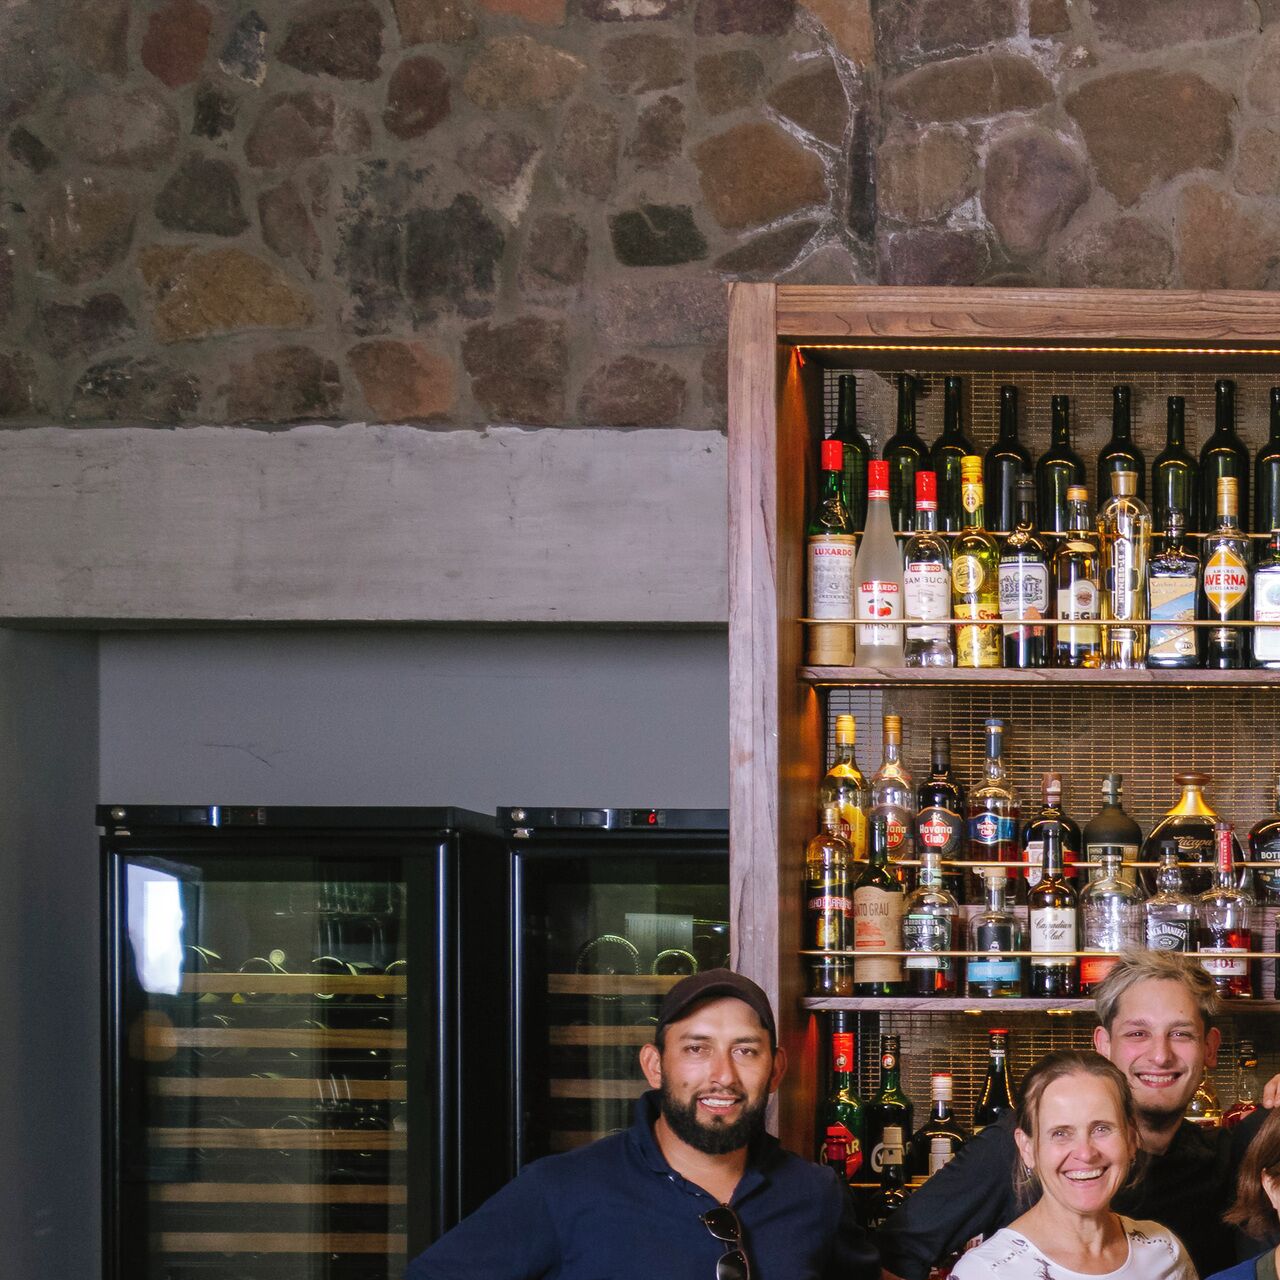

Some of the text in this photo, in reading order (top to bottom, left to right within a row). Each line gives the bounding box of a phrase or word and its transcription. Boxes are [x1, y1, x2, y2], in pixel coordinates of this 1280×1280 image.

[814, 548, 853, 557] LUXARDO
[1001, 555, 1039, 563] ABSINTHE
[1205, 574, 1246, 586] AVERNA
[1001, 582, 1040, 593] ABSENTE
[919, 824, 953, 834] Havana
[924, 833, 945, 844] Club
[868, 902, 890, 917] GRAU
[1034, 917, 1073, 929] Canadian
[1146, 924, 1187, 940] JACK DANIEL'S
[1212, 959, 1236, 969] 101
